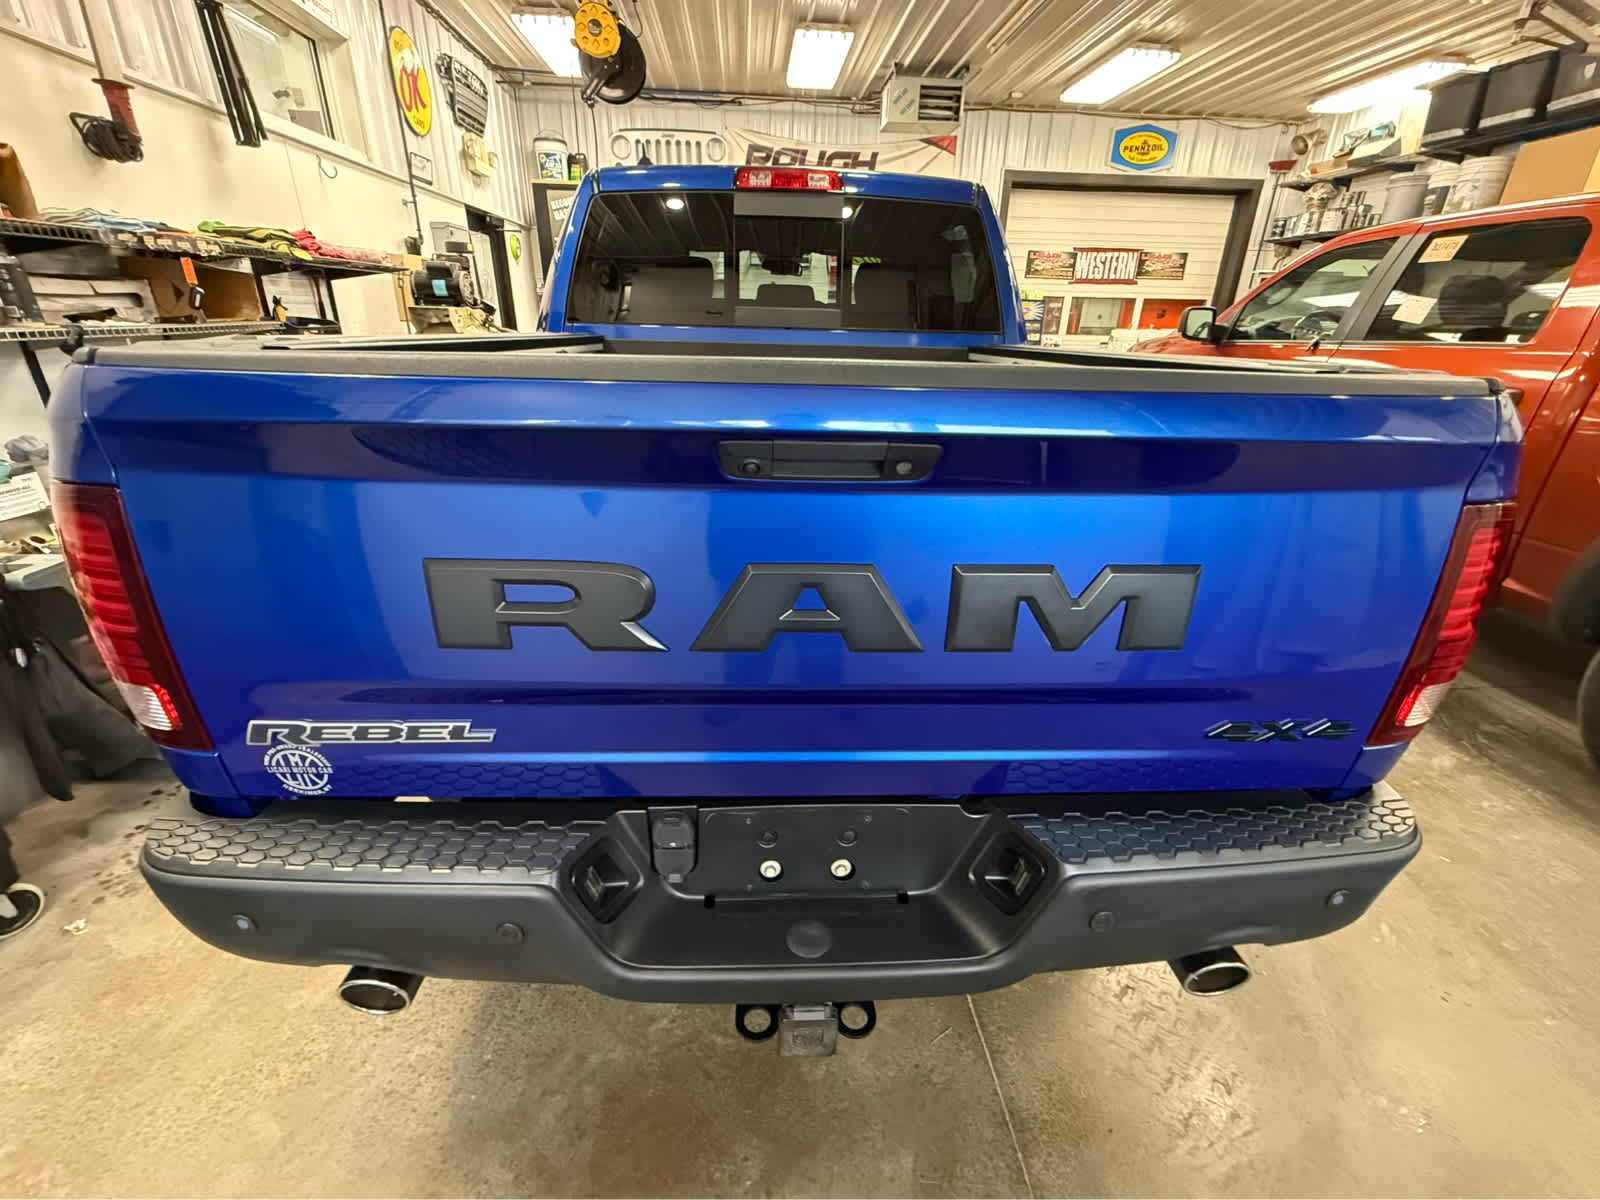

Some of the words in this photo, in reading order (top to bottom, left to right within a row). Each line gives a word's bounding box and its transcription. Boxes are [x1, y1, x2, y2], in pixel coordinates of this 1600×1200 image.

[399, 64, 427, 113] OK
[745, 144, 879, 171] ROUGH
[1123, 144, 1165, 152] PENNZOIL
[1075, 251, 1138, 280] WESTERN
[423, 557, 1202, 651] RAM
[246, 719, 497, 747] REBEL
